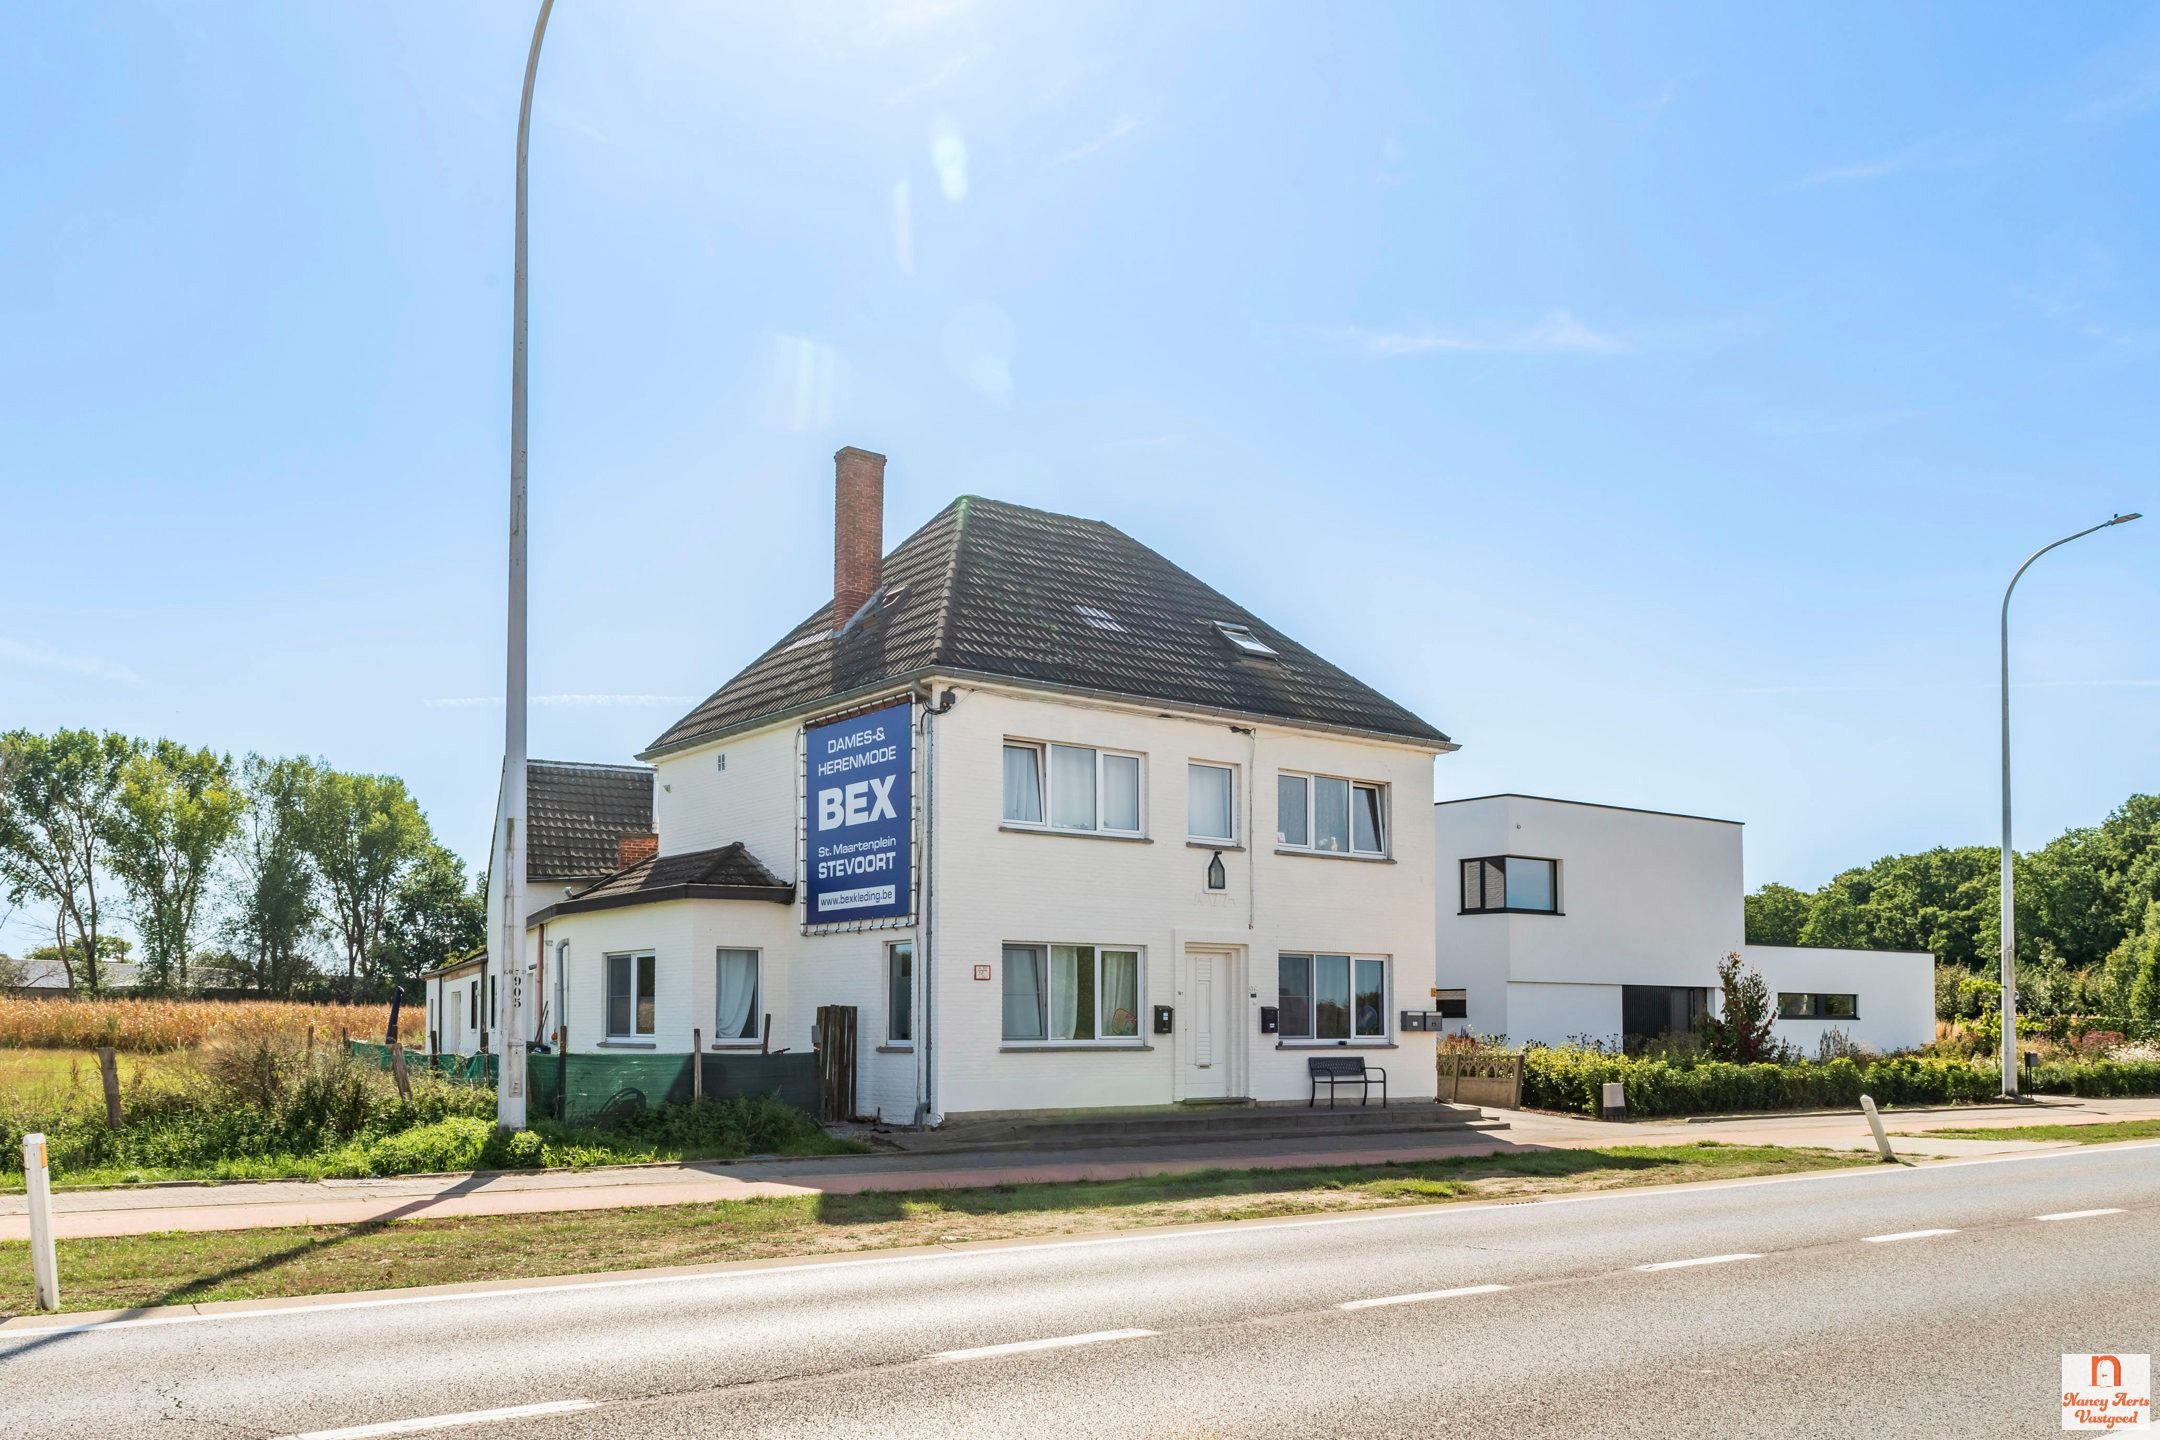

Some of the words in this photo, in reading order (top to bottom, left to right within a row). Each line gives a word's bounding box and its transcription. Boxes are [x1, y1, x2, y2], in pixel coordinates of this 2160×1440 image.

[828, 727, 885, 754] DAMES-&
[818, 746, 897, 776] HERENMODE
[818, 774, 897, 832] BEX
[818, 846, 832, 858] St.
[833, 836, 897, 856] Maartenplein
[818, 852, 897, 879] STEVOORT
[820, 890, 893, 907] www.bexkleding.be
[513, 976, 522, 1008] 905
